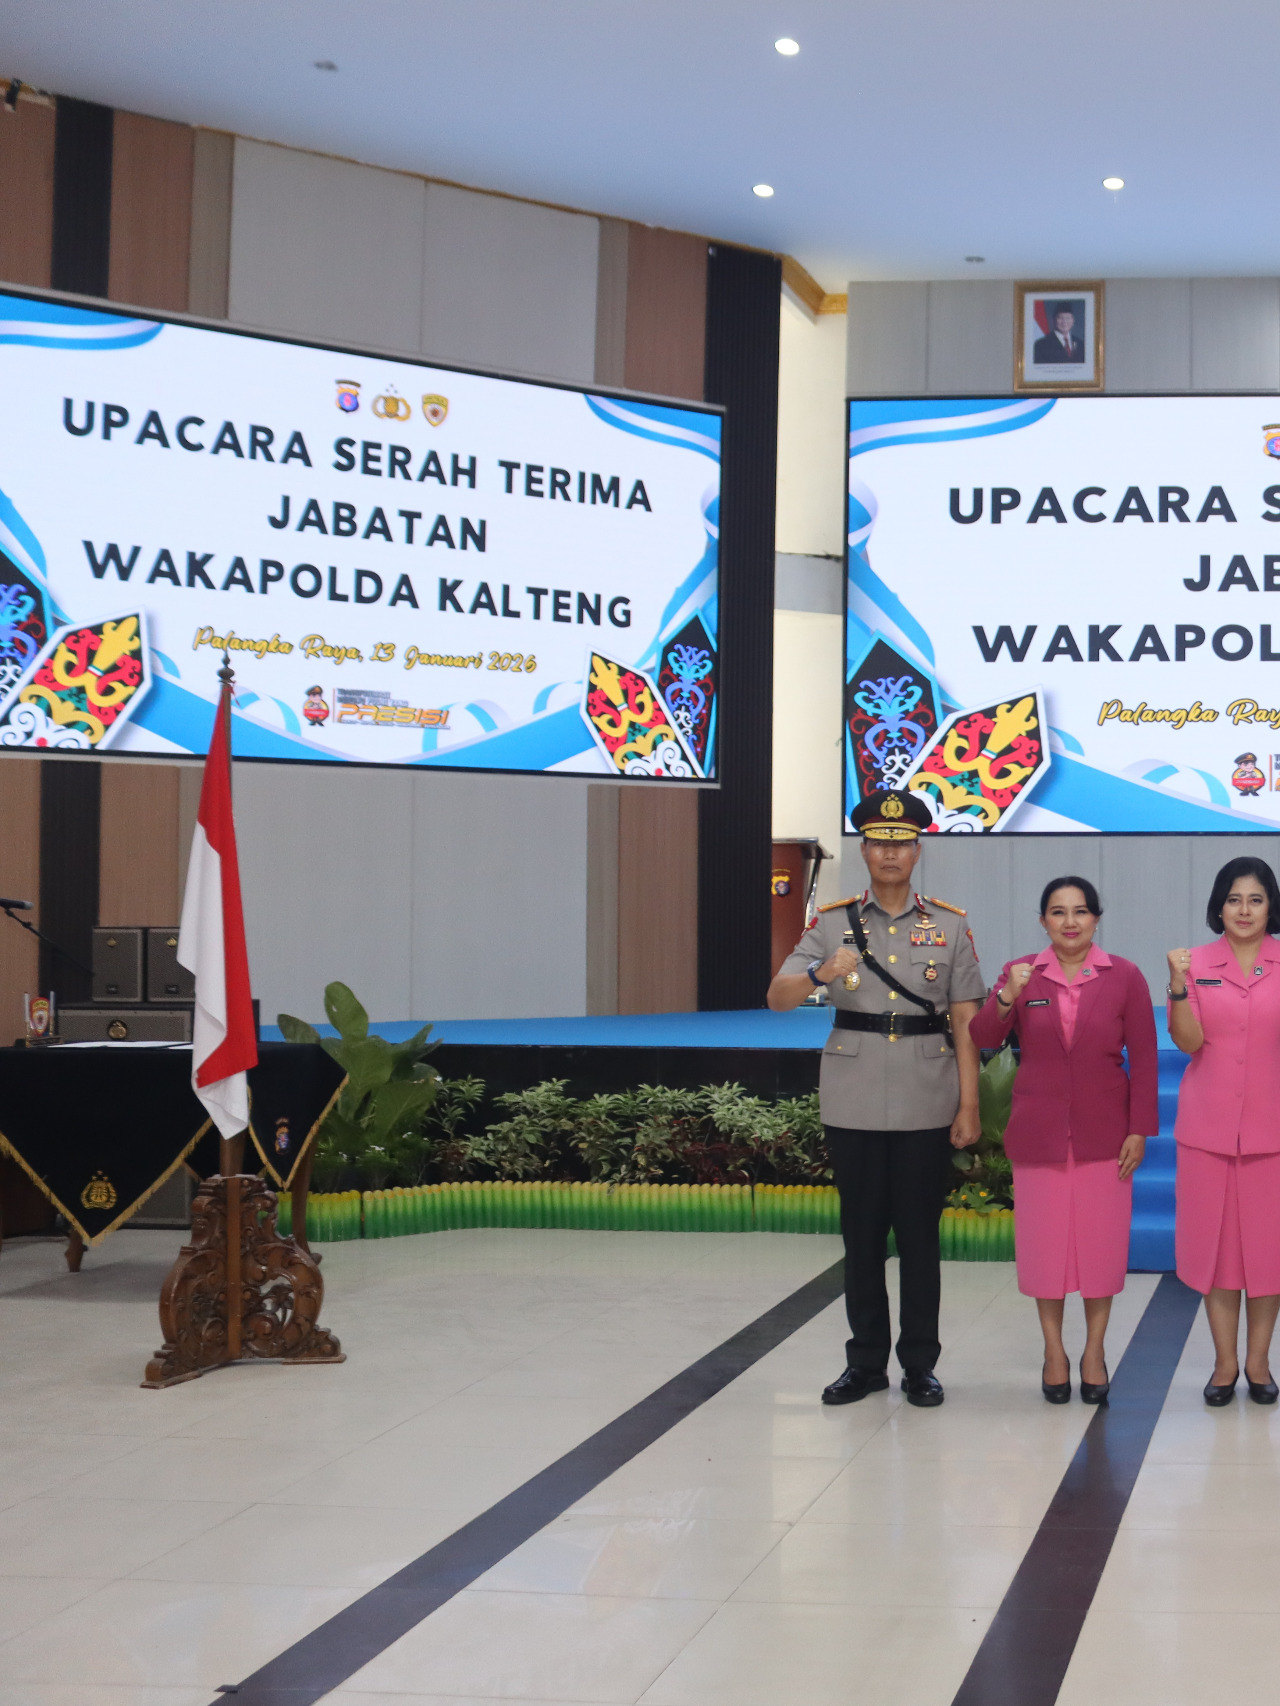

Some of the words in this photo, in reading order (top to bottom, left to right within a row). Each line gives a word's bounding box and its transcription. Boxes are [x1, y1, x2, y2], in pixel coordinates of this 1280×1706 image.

[63, 397, 313, 468] UPACARA
[332, 437, 477, 489] SERAH
[498, 459, 653, 513] TERIMA
[267, 495, 487, 553] JABATAN
[949, 485, 1238, 525] UPACARA
[82, 540, 420, 609] WAKAPOLDA
[438, 577, 631, 629] KALTENG
[192, 625, 294, 659] Palangka
[299, 634, 364, 665] Raya,
[369, 642, 396, 662] 13
[403, 645, 484, 671] Januari
[486, 651, 538, 673] 2026
[336, 703, 450, 725] PRESISI
[1097, 698, 1220, 730] Palangka
